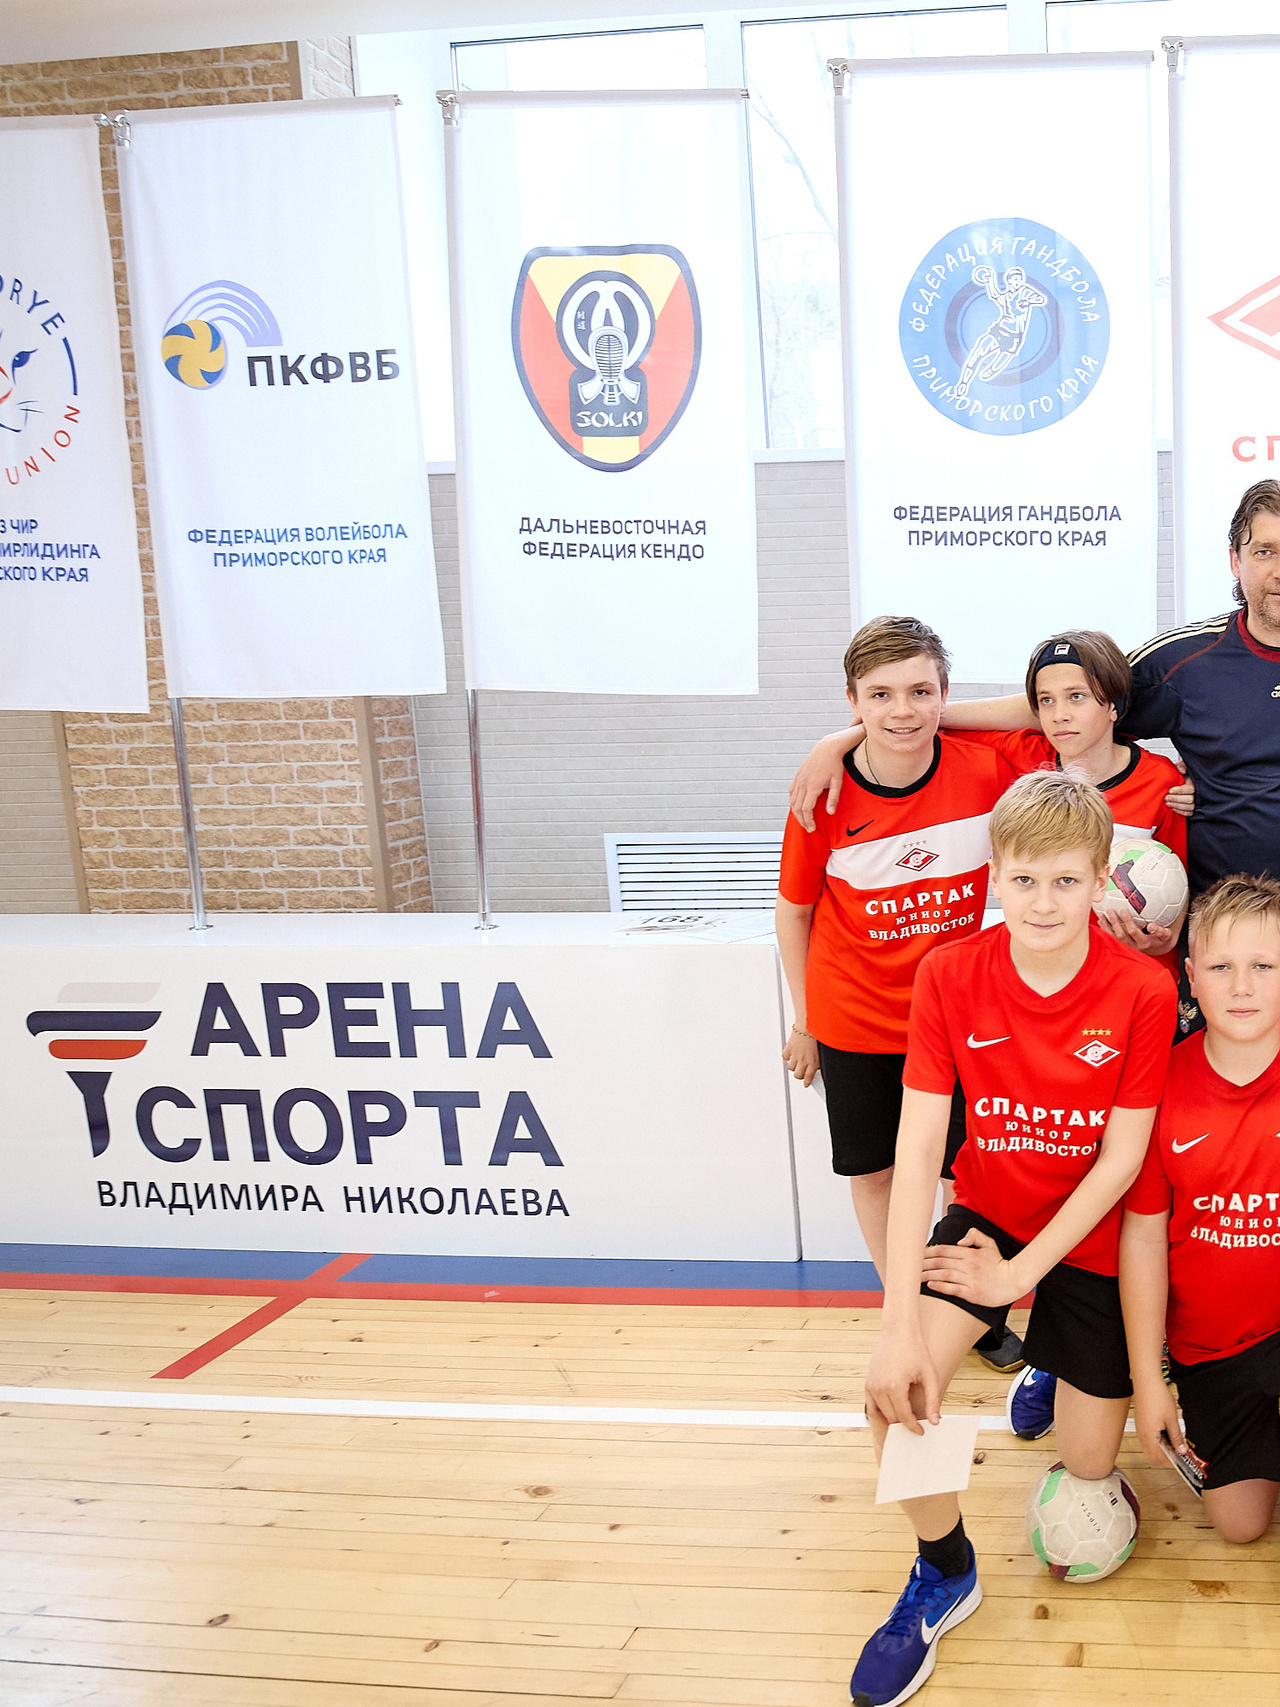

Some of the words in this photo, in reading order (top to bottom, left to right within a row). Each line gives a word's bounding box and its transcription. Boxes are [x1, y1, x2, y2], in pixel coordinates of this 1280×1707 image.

[909, 237, 1003, 332] ФЕДЕРАЦИЯ
[1011, 237, 1101, 322] ГАНДБОЛА
[0, 275, 65, 335] RYE
[247, 349, 400, 387] ПКФВБ
[913, 355, 1053, 421] ПРИМОРСКОГО
[1057, 355, 1099, 401] КРАЯ
[576, 411, 643, 428] SOLKI
[6, 405, 80, 485] UNION
[10, 519, 39, 534] ЧИР
[519, 517, 707, 535] ДАЛЬНЕВОСТОЧНАЯ
[893, 505, 1013, 524] ФЕДЕРАЦИЯ
[1018, 505, 1122, 524] ГАНДБОЛА
[188, 528, 300, 546] ФЕДЕРАЦИЯ
[305, 522, 408, 542] ВОЛЕЙБОЛА
[908, 530, 1052, 546] ПРИМОРСКОГО
[1058, 530, 1107, 546] КРАЯ
[0, 543, 101, 560] ИРЛИДИНГА
[213, 550, 343, 567] ПРИМОРСКОГО
[348, 548, 387, 564] КРАЯ
[522, 541, 637, 561] ФЕДЕРАЦИЯ
[641, 544, 705, 561] КЕНДО
[41, 566, 89, 583] КРАЯ
[865, 883, 975, 915] СПАРТАК
[868, 912, 975, 940] ВЛАДИВОСТОК
[896, 909, 951, 925] ЮНИОР
[190, 981, 554, 1058] АРЕНА
[974, 1097, 1107, 1127] СПАРТАК
[135, 1085, 565, 1168] СПОРТА
[1005, 1121, 1071, 1140] ЮНИОР
[98, 1179, 325, 1216] ВЛАДИМИРА
[344, 1184, 570, 1218] НИКОЛАЕВА
